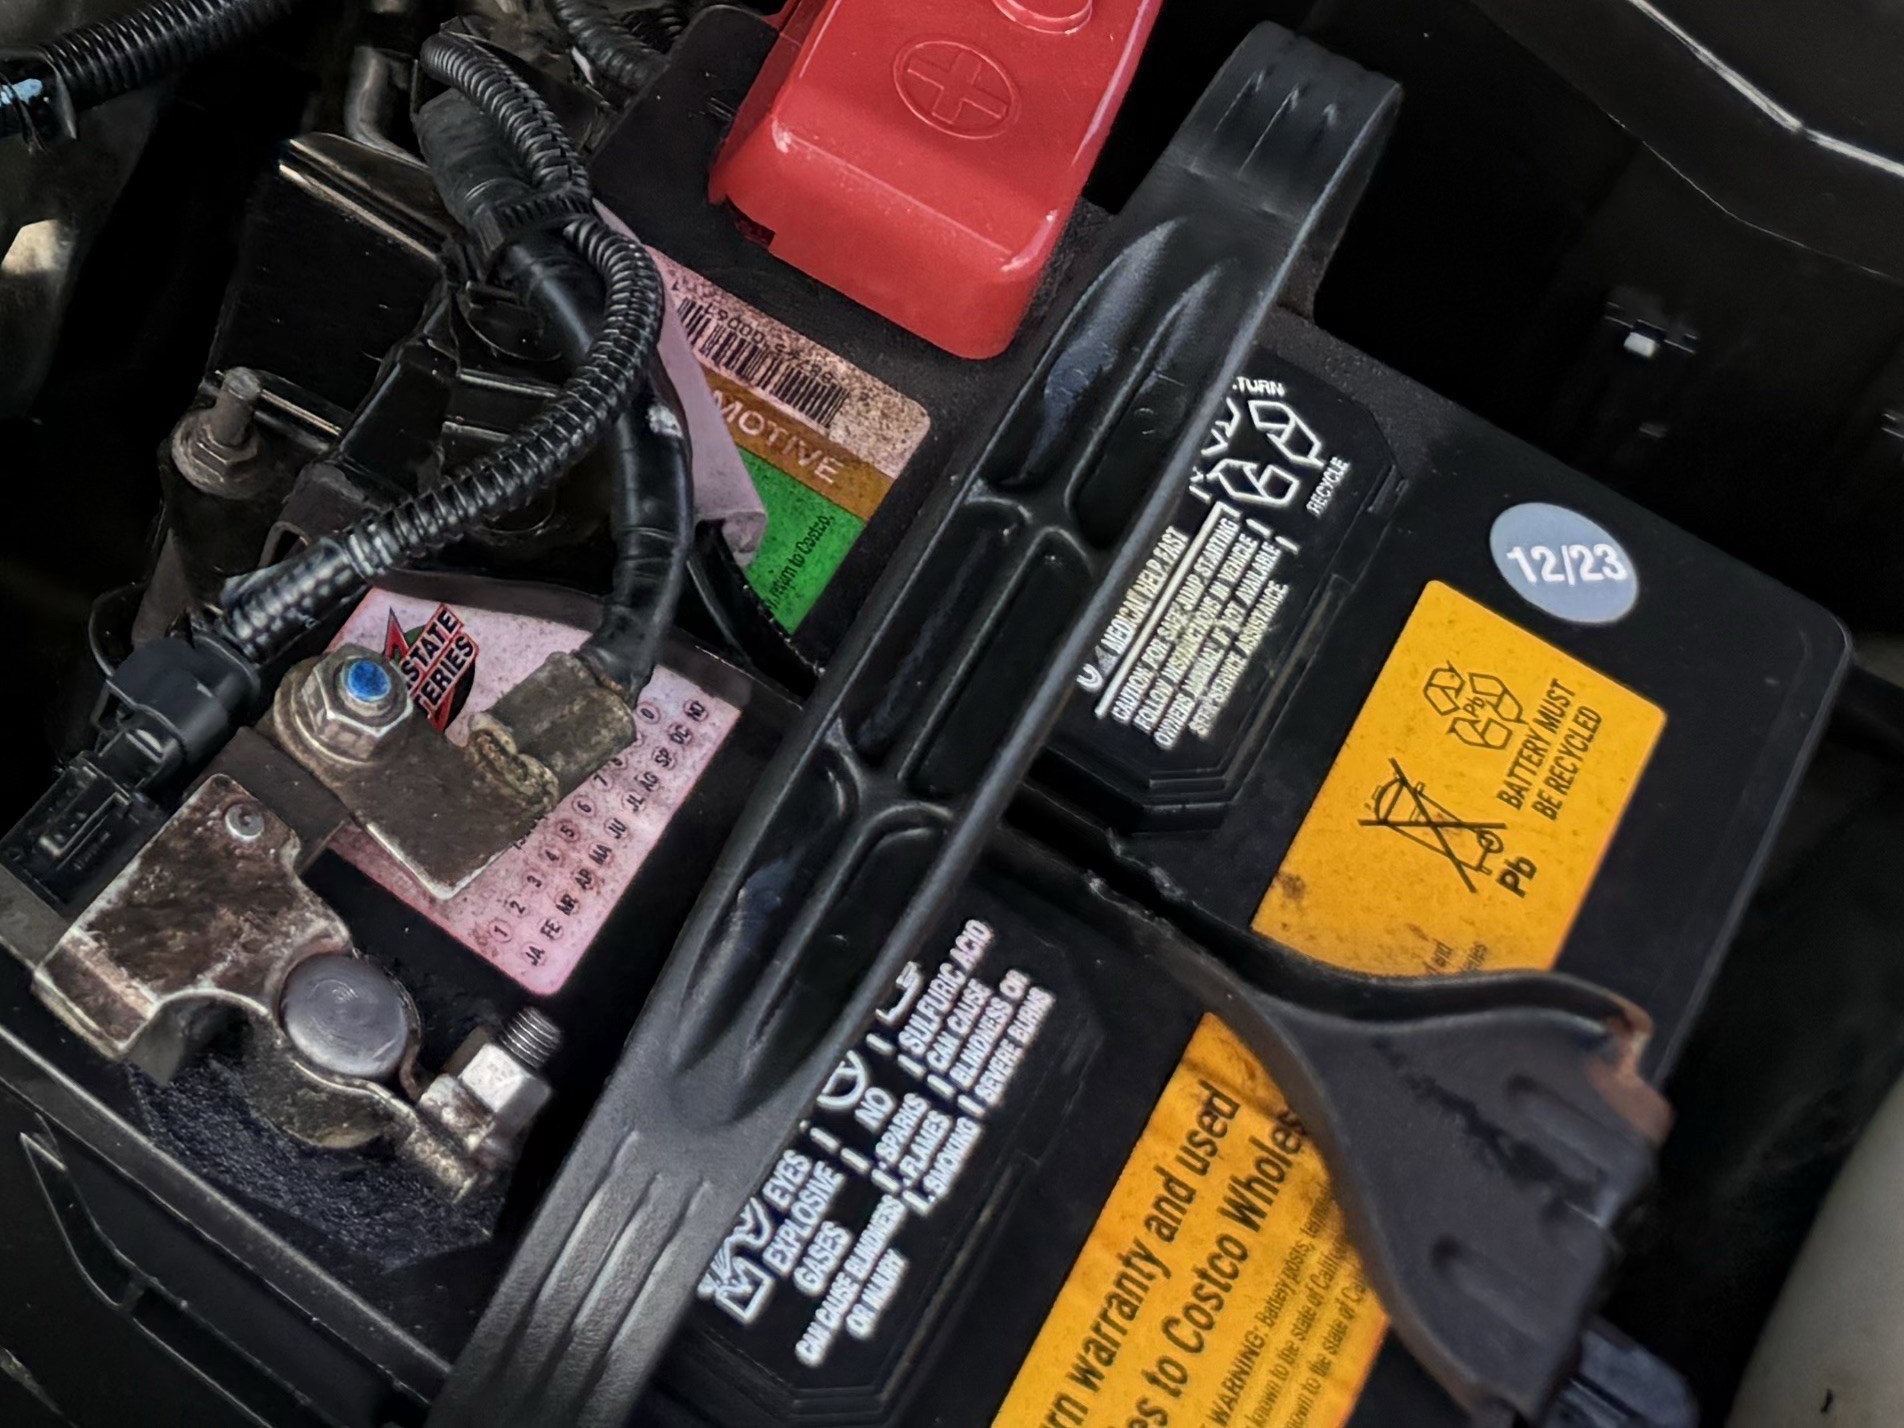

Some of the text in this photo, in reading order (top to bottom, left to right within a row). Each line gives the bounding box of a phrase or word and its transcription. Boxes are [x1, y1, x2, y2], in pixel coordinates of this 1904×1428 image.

[713, 389, 846, 484] MOTIVE
[1304, 454, 1349, 517] RECYCLE
[1152, 525, 1190, 565] FAST
[1192, 516, 1240, 579] STARTING
[1506, 544, 1628, 586] 12/23
[1132, 677, 1176, 732] FOLLOW
[1216, 532, 1259, 586] VEHICLE
[1219, 599, 1249, 631] NOT
[1460, 691, 1487, 718] Pb
[1495, 676, 1577, 811] BATTERY MUST
[1531, 703, 1604, 822] BE RECYCLED
[1494, 849, 1539, 898] Pb
[894, 915, 996, 1059] SULFURIC ACID
[922, 976, 994, 1076] CAN CAUSE
[971, 984, 1057, 1107] SEVERE BURNS
[851, 1082, 898, 1134] NO
[872, 1090, 931, 1167] SPARKS
[1164, 1077, 1243, 1178] used
[759, 1145, 815, 1211] EYES
[761, 1158, 846, 1276] EXPLOSIVE
[1129, 1161, 1200, 1247] and
[789, 1218, 854, 1298] GASES
[1154, 1224, 1254, 1359] Costco
[1061, 1233, 1178, 1395] warranty
[1203, 1321, 1271, 1428] WARNING:
[1253, 1276, 1297, 1331] Battery
[1137, 1347, 1192, 1400] to
